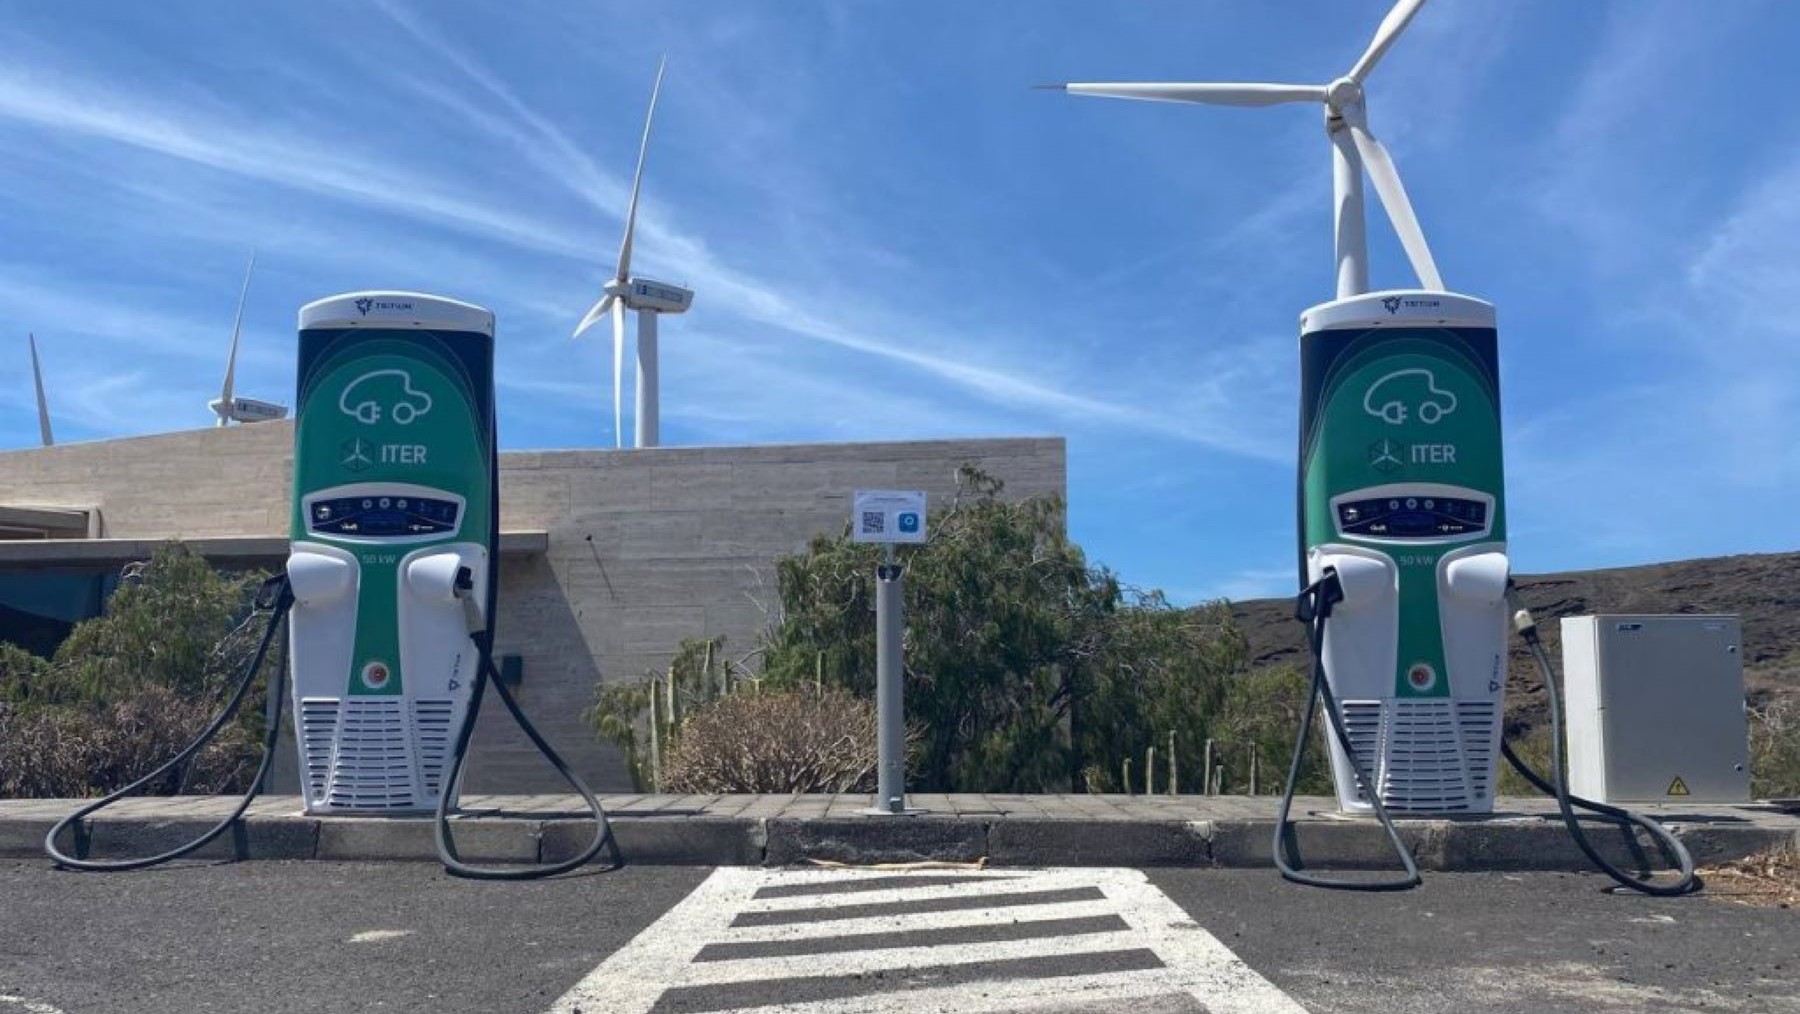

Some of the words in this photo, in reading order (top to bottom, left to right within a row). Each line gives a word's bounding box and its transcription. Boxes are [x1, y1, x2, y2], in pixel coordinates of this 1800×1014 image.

[382, 444, 427, 463] ITER
[1411, 444, 1456, 463] ITER
[362, 554, 376, 564] 50
[378, 554, 396, 564] kW
[1400, 555, 1414, 565] 50
[1417, 555, 1434, 565] kW
